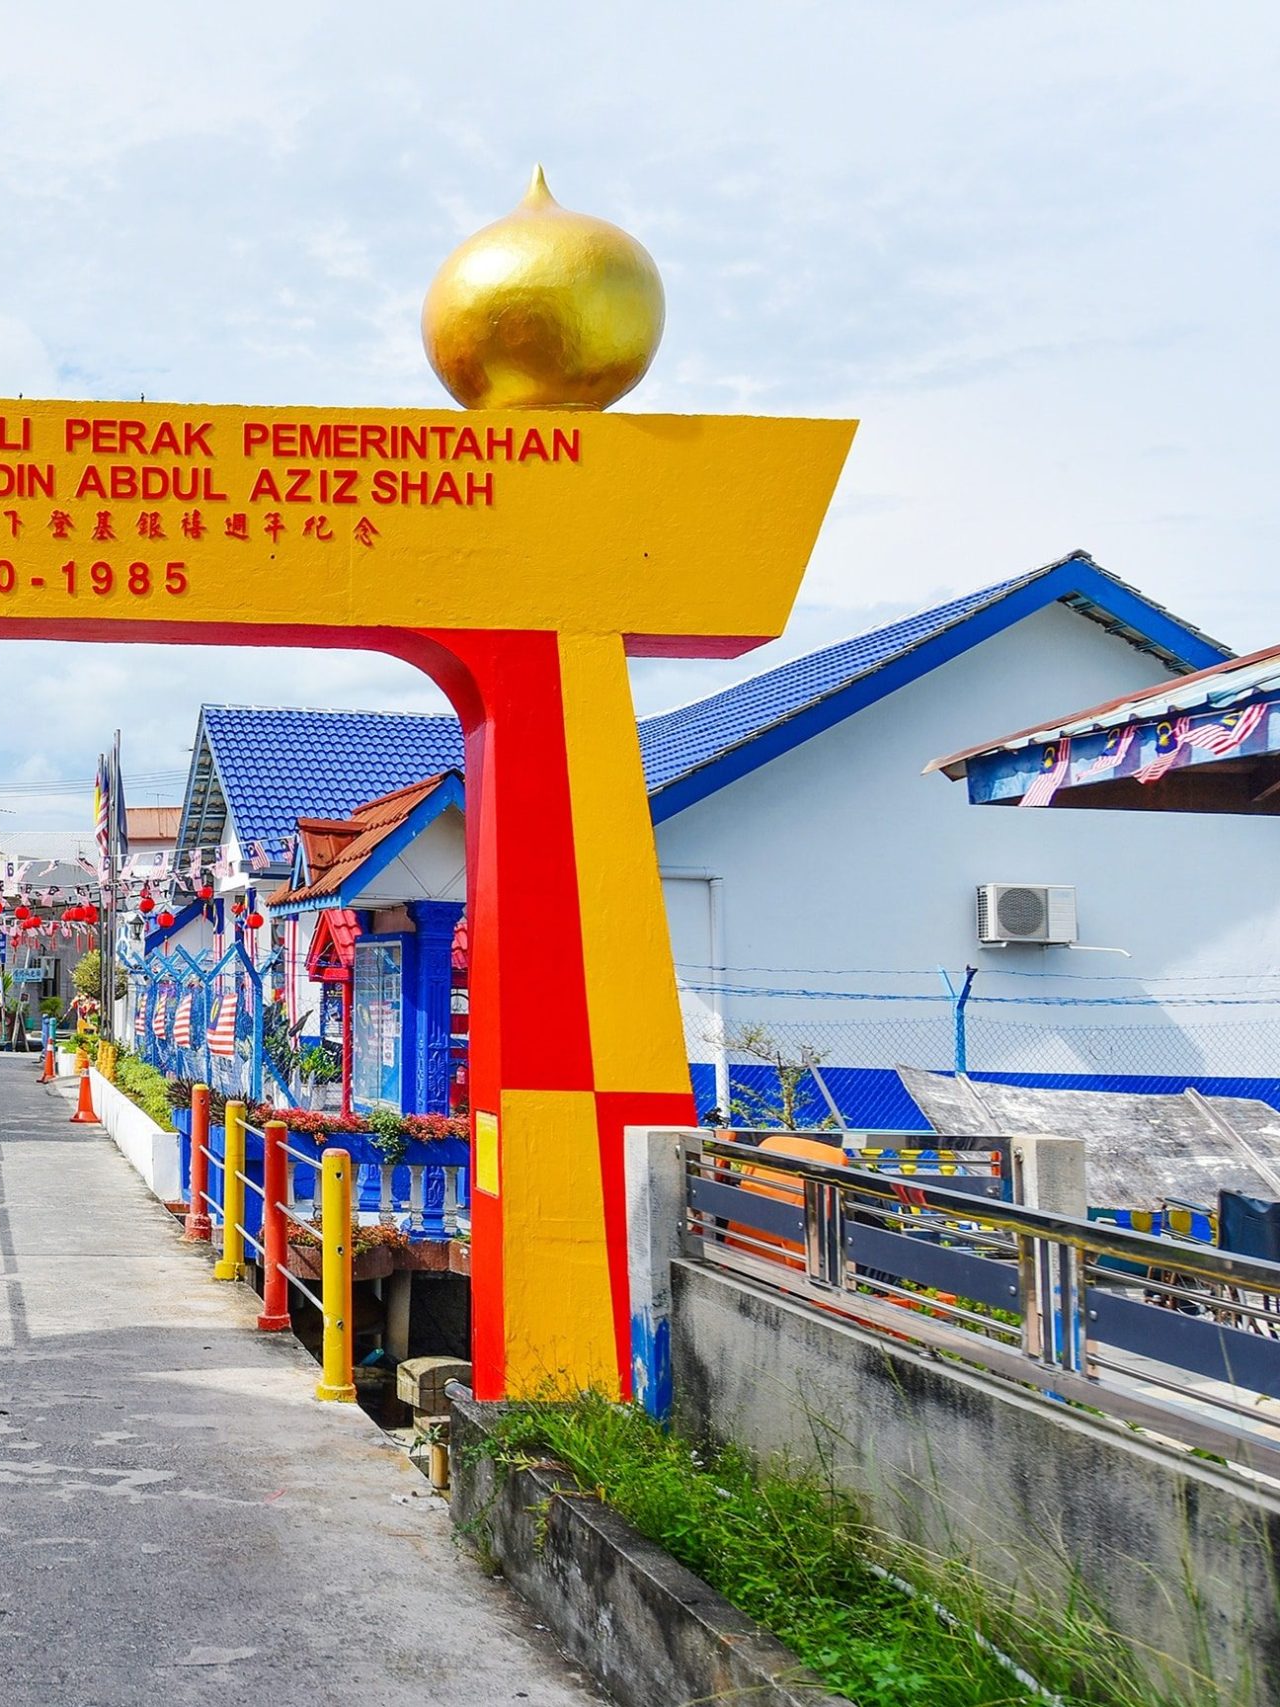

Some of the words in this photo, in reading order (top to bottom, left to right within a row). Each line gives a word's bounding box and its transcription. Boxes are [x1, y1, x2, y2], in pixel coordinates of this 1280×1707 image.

[65, 418, 214, 457] PERAK
[243, 422, 581, 463] PEMERINTAHAN
[75, 465, 228, 502] ABDUL
[249, 468, 359, 505] AZIZ
[371, 469, 495, 506] SHAH
